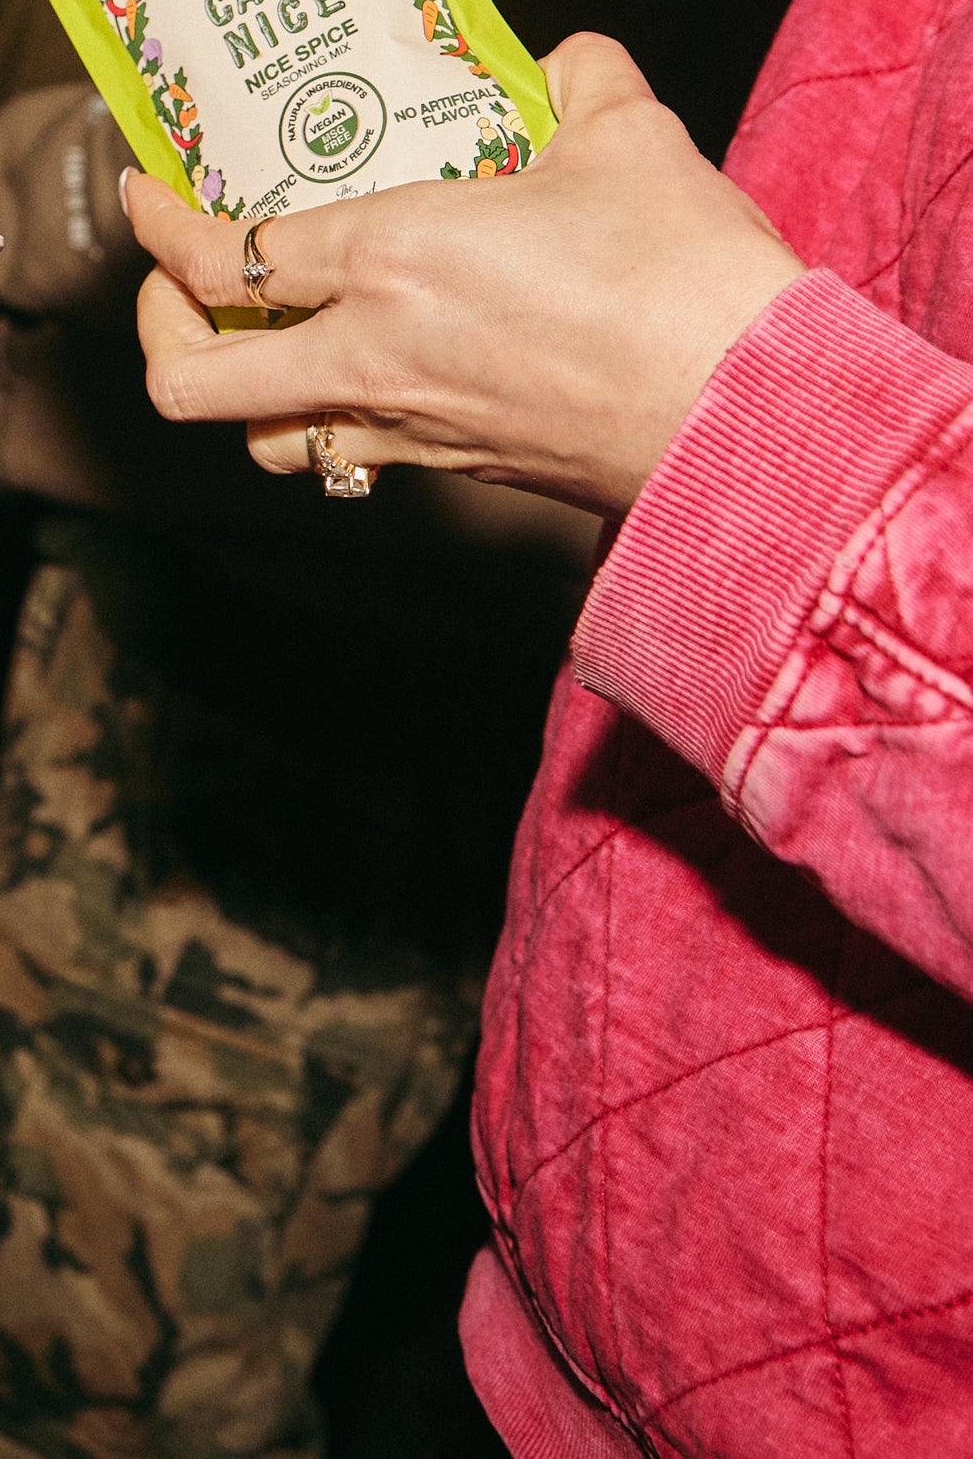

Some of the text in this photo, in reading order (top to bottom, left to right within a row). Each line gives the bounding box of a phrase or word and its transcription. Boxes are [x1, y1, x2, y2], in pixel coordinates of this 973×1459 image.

[244, 18, 358, 94] NICE SPICE
[261, 41, 352, 100] SEASONING MIX
[288, 80, 368, 142] NATURAL INGREDIENTS
[393, 87, 496, 123] NO ARTIFICIAL
[421, 103, 481, 128] FLAVOR
[309, 108, 347, 135] VEGAN
[321, 124, 346, 144] MSG
[309, 128, 375, 174] A FAMILY RECIPE
[323, 131, 352, 153] FREE
[261, 195, 291, 217] STE
